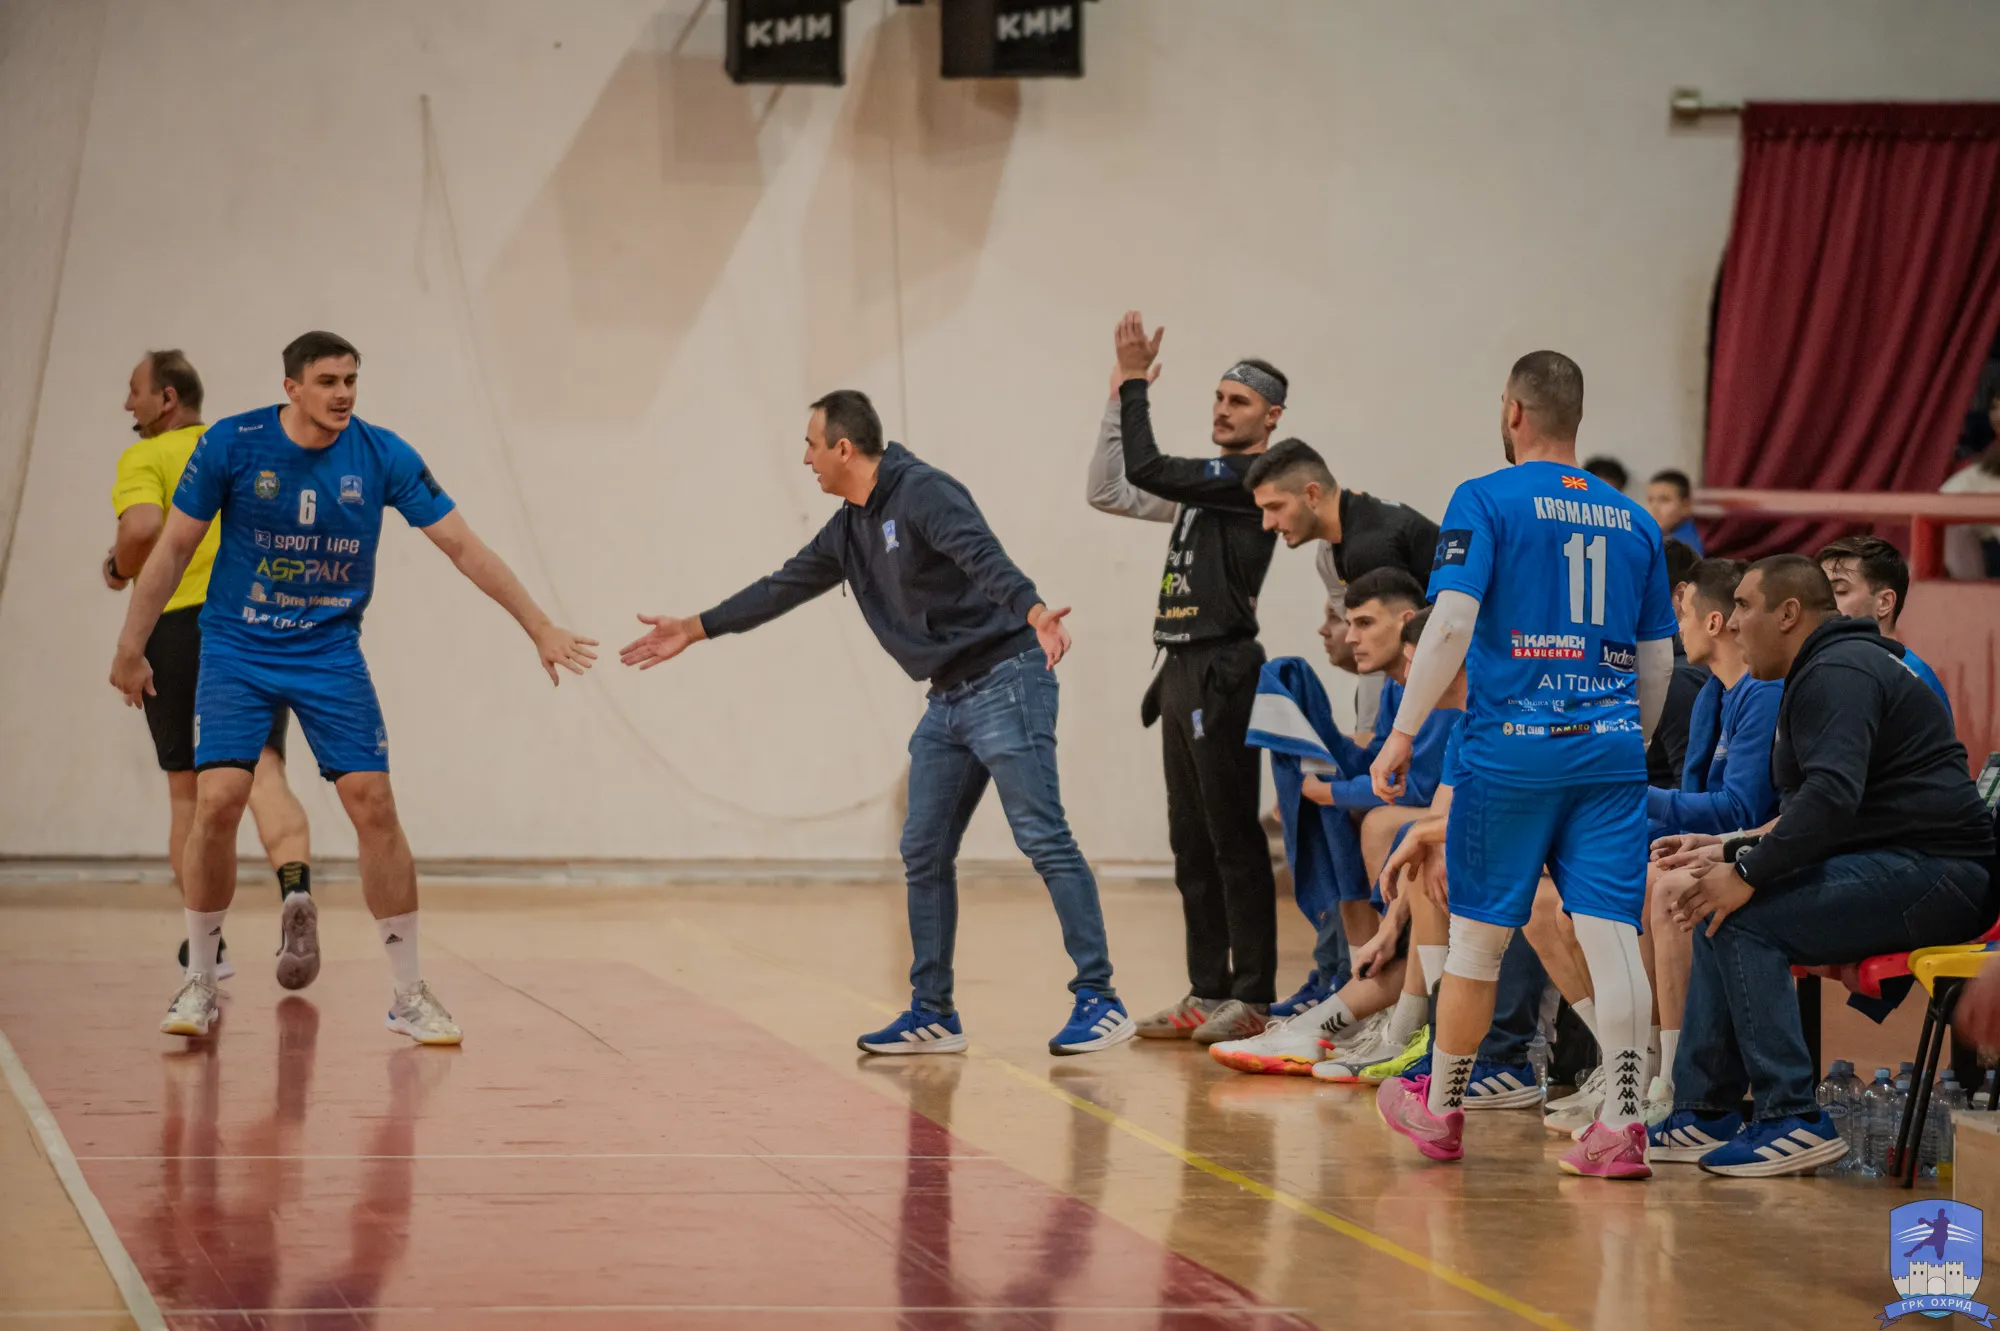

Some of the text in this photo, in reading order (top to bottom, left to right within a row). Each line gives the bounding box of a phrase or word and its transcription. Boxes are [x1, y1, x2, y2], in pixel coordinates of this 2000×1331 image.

[299, 489, 317, 525] 6
[1533, 496, 1632, 532] KRSMANCIC
[275, 535, 321, 551] SPORT
[1563, 532, 1607, 626] 11
[1524, 634, 1585, 650] КАРМЕН
[1537, 673, 1626, 693] AITONIX
